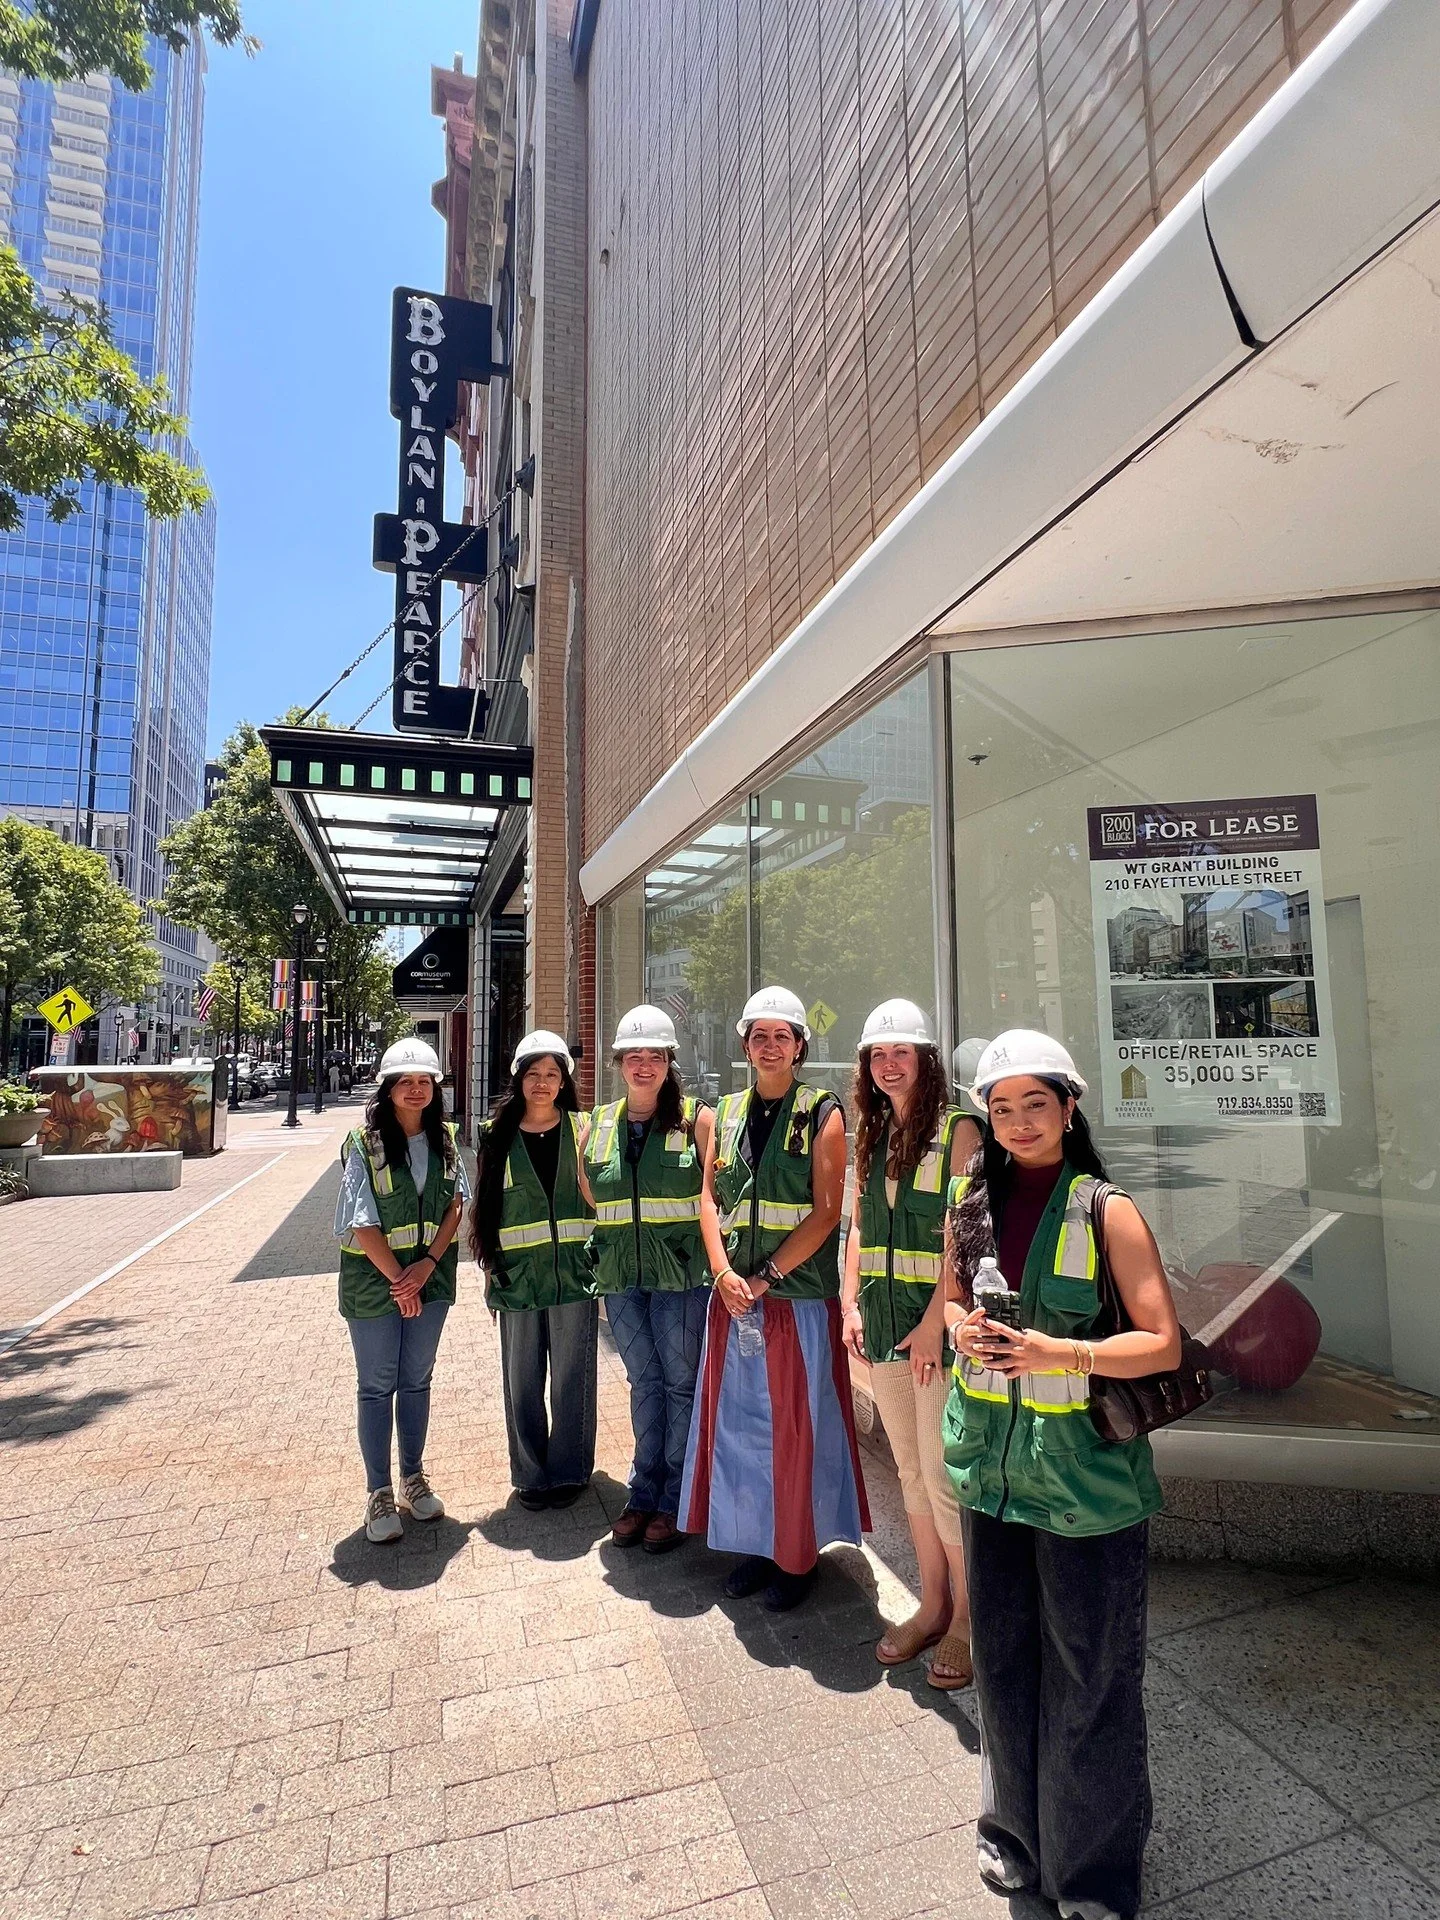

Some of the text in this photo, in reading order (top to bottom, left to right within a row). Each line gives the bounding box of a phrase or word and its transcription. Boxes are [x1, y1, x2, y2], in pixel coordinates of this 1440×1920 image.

[1105, 816, 1132, 833] 200
[1144, 814, 1299, 840] FOR LEASE
[1107, 831, 1132, 842] BLOCK
[1125, 856, 1279, 874] WT GRANT BUILDING
[1105, 871, 1302, 890] 210 FAYETTEVILLE STREET
[1118, 1043, 1317, 1060] OFFICE/RETAIL SPACE
[1164, 1065, 1269, 1086] 35,000 SF
[1216, 1096, 1293, 1109] 919.834.8350
